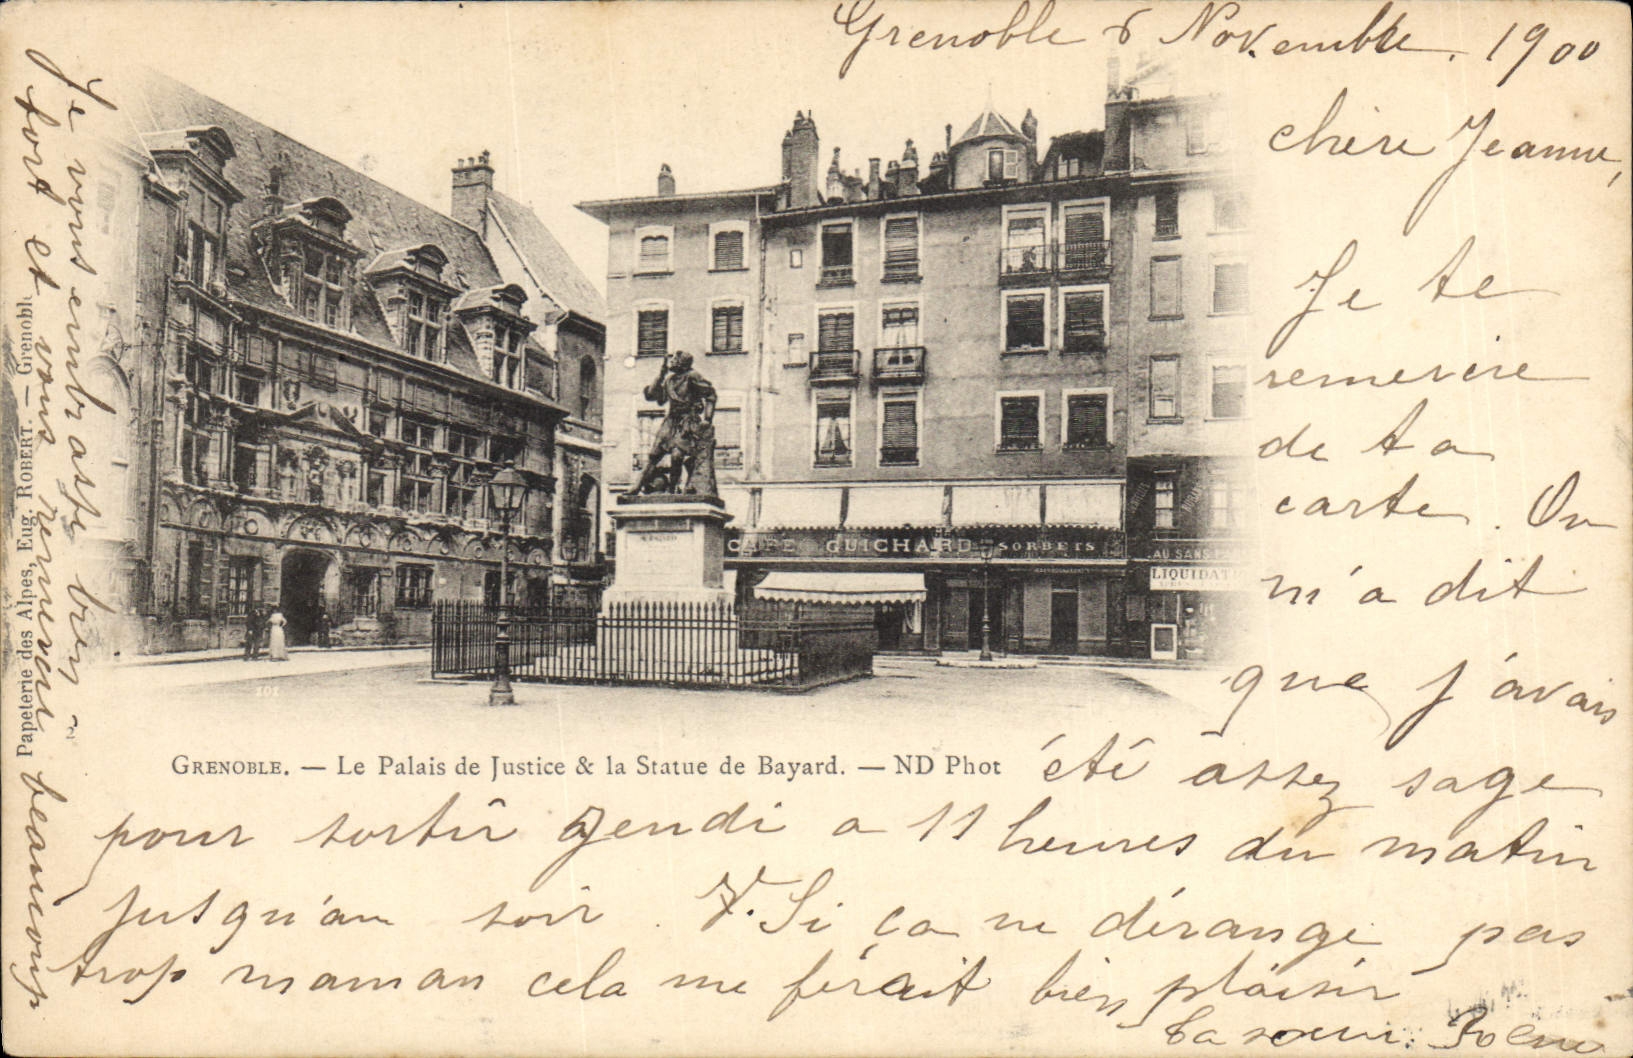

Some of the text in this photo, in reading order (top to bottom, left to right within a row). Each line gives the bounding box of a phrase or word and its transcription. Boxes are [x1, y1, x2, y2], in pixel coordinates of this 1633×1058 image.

[834, 0, 1086, 79] Grenoble
[1486, 21, 1600, 86] 1900
[14, 85, 67, 206] fort
[66, 158, 98, 276] vous
[24, 234, 61, 296] et
[1265, 235, 1561, 359] Je te
[34, 336, 56, 444] vous
[1258, 398, 1495, 462] de ta
[1528, 470, 1618, 531] On
[826, 537, 972, 553] GUICHARD
[998, 540, 1096, 551] SORBETS
[1424, 554, 1589, 607] dit
[1200, 664, 1392, 737] que
[1042, 733, 1154, 781] été
[1391, 765, 1604, 842] sage
[9, 771, 68, 1009] beaucoup
[53, 812, 254, 906] pour
[905, 801, 989, 841] 11
[998, 796, 1198, 855] heures
[1226, 833, 1334, 862] du
[1360, 816, 1598, 870] matin
[983, 912, 1057, 934] ne
[1411, 921, 1588, 976] pas
[46, 952, 188, 1005] trop
[220, 964, 485, 995] maman
[528, 947, 628, 1000] cela
[659, 973, 747, 995] me
[1028, 948, 1130, 1029] bien
[1118, 948, 1402, 1026] plaisir
